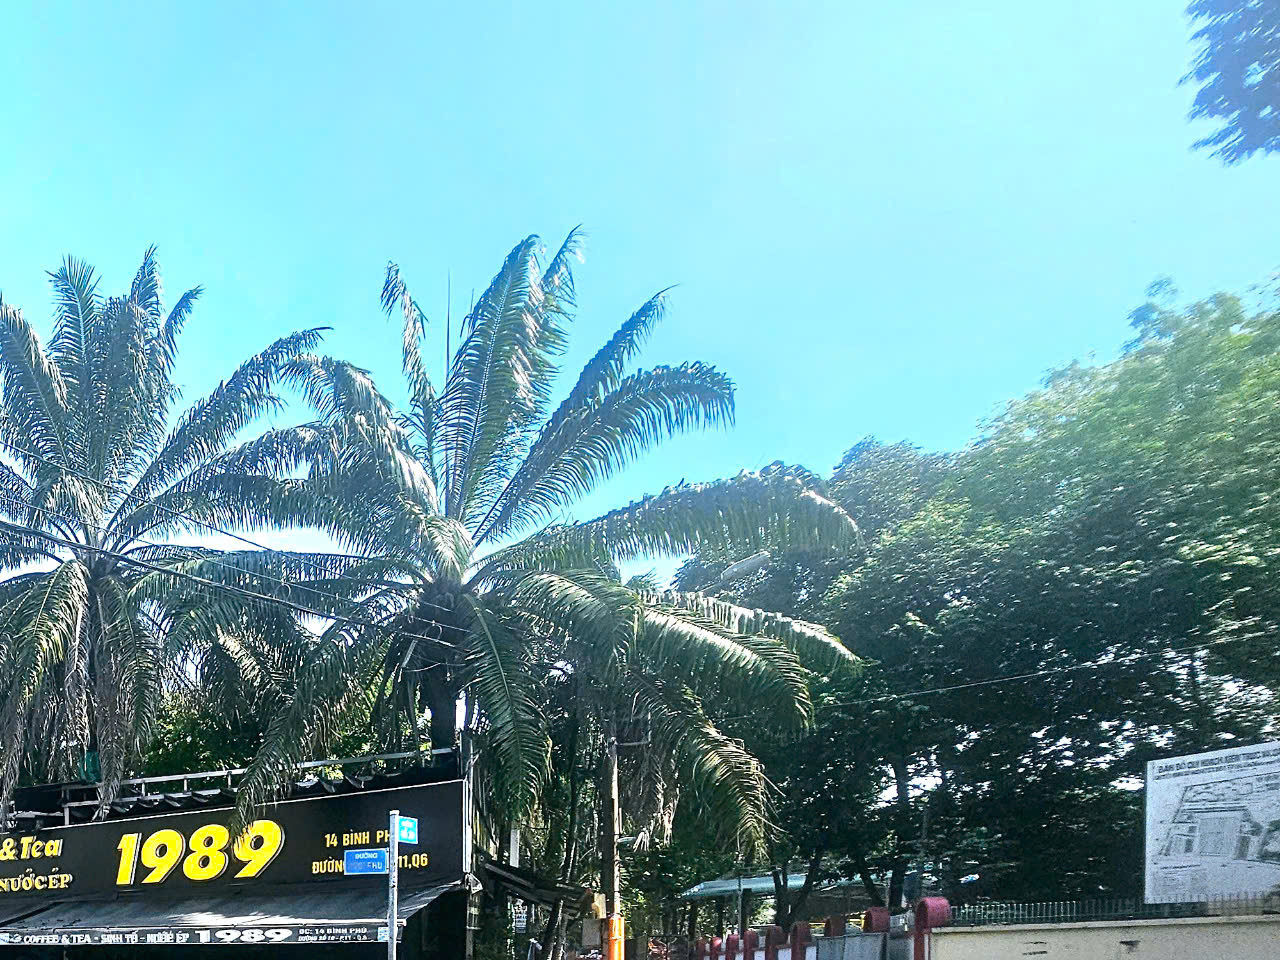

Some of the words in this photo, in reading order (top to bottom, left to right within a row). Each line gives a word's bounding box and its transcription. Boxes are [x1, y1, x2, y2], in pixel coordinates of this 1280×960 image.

[20, 836, 64, 860] Tea
[324, 833, 338, 848] 14
[342, 829, 370, 846] BÌNH
[376, 830, 390, 843] PH
[115, 820, 285, 885] 1989
[312, 856, 345, 874] ĐƯỜN
[48, 867, 73, 889] ÉP
[23, 936, 60, 944] COFFEE
[70, 935, 92, 943] TEA
[195, 928, 293, 943] 1989
